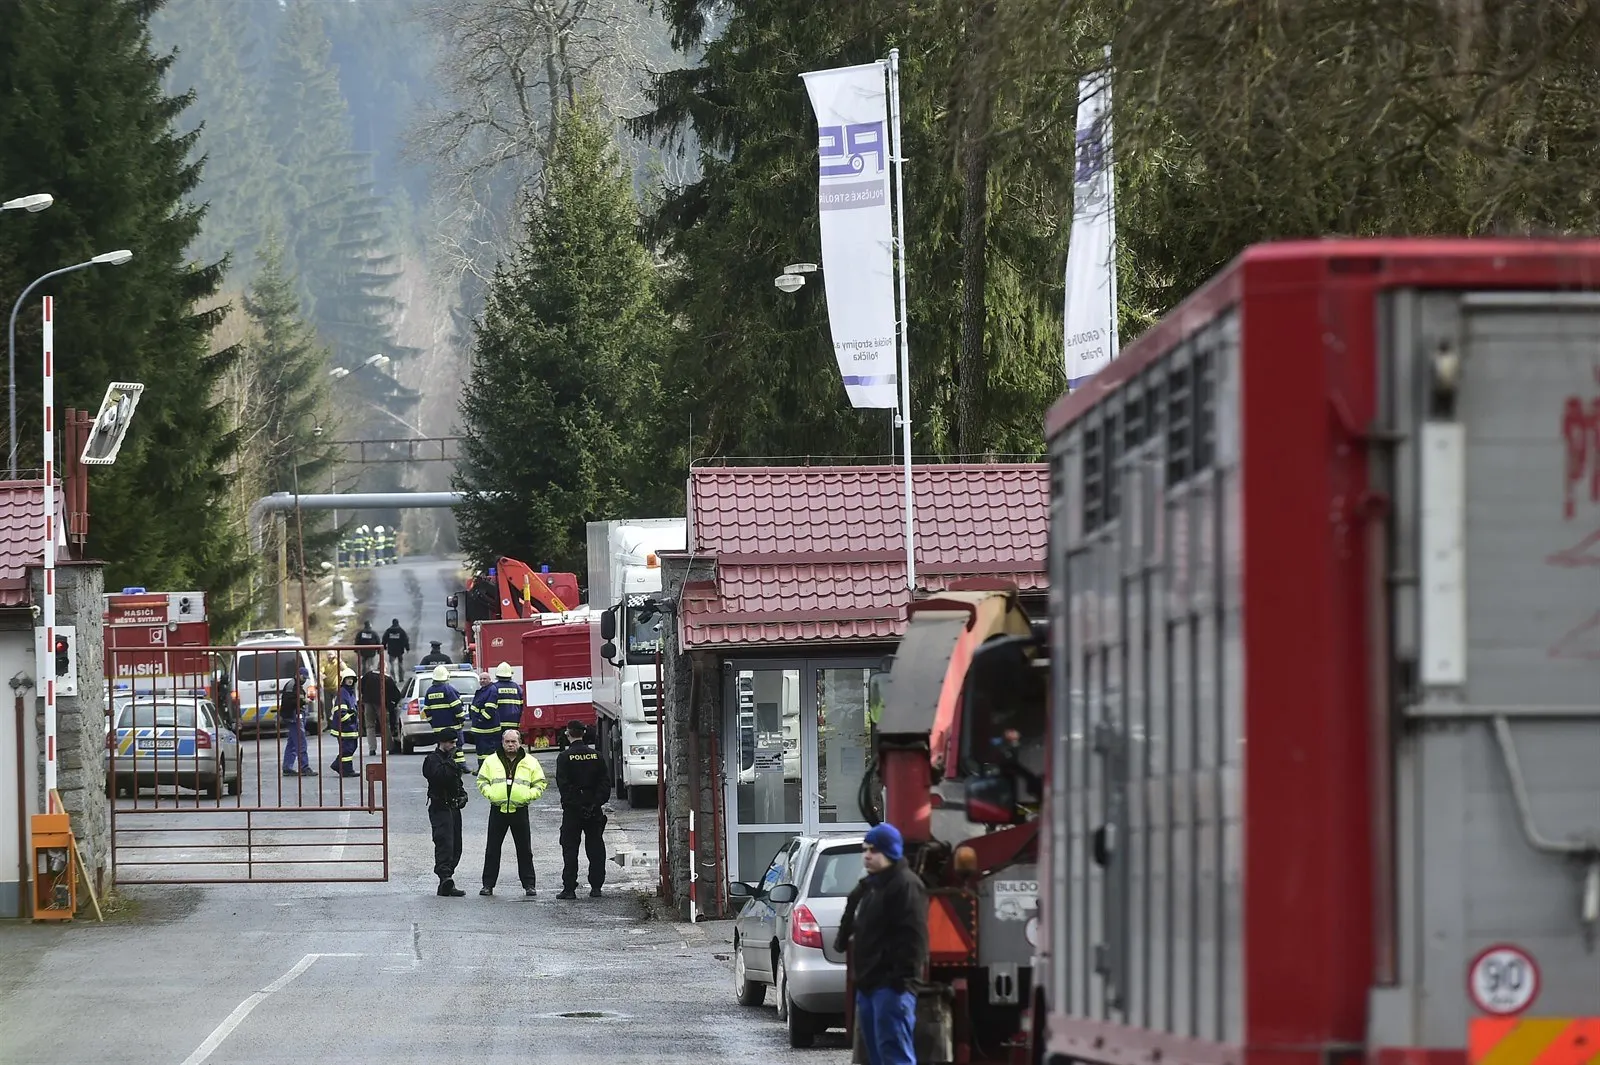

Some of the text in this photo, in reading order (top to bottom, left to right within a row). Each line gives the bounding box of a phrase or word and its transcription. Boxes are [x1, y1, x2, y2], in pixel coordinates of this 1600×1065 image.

[124, 608, 154, 616] HASIČI
[563, 677, 593, 692] HASIČ
[569, 753, 598, 761] POLICIE
[996, 881, 1039, 893] BULDO
[1485, 959, 1525, 992] 90
